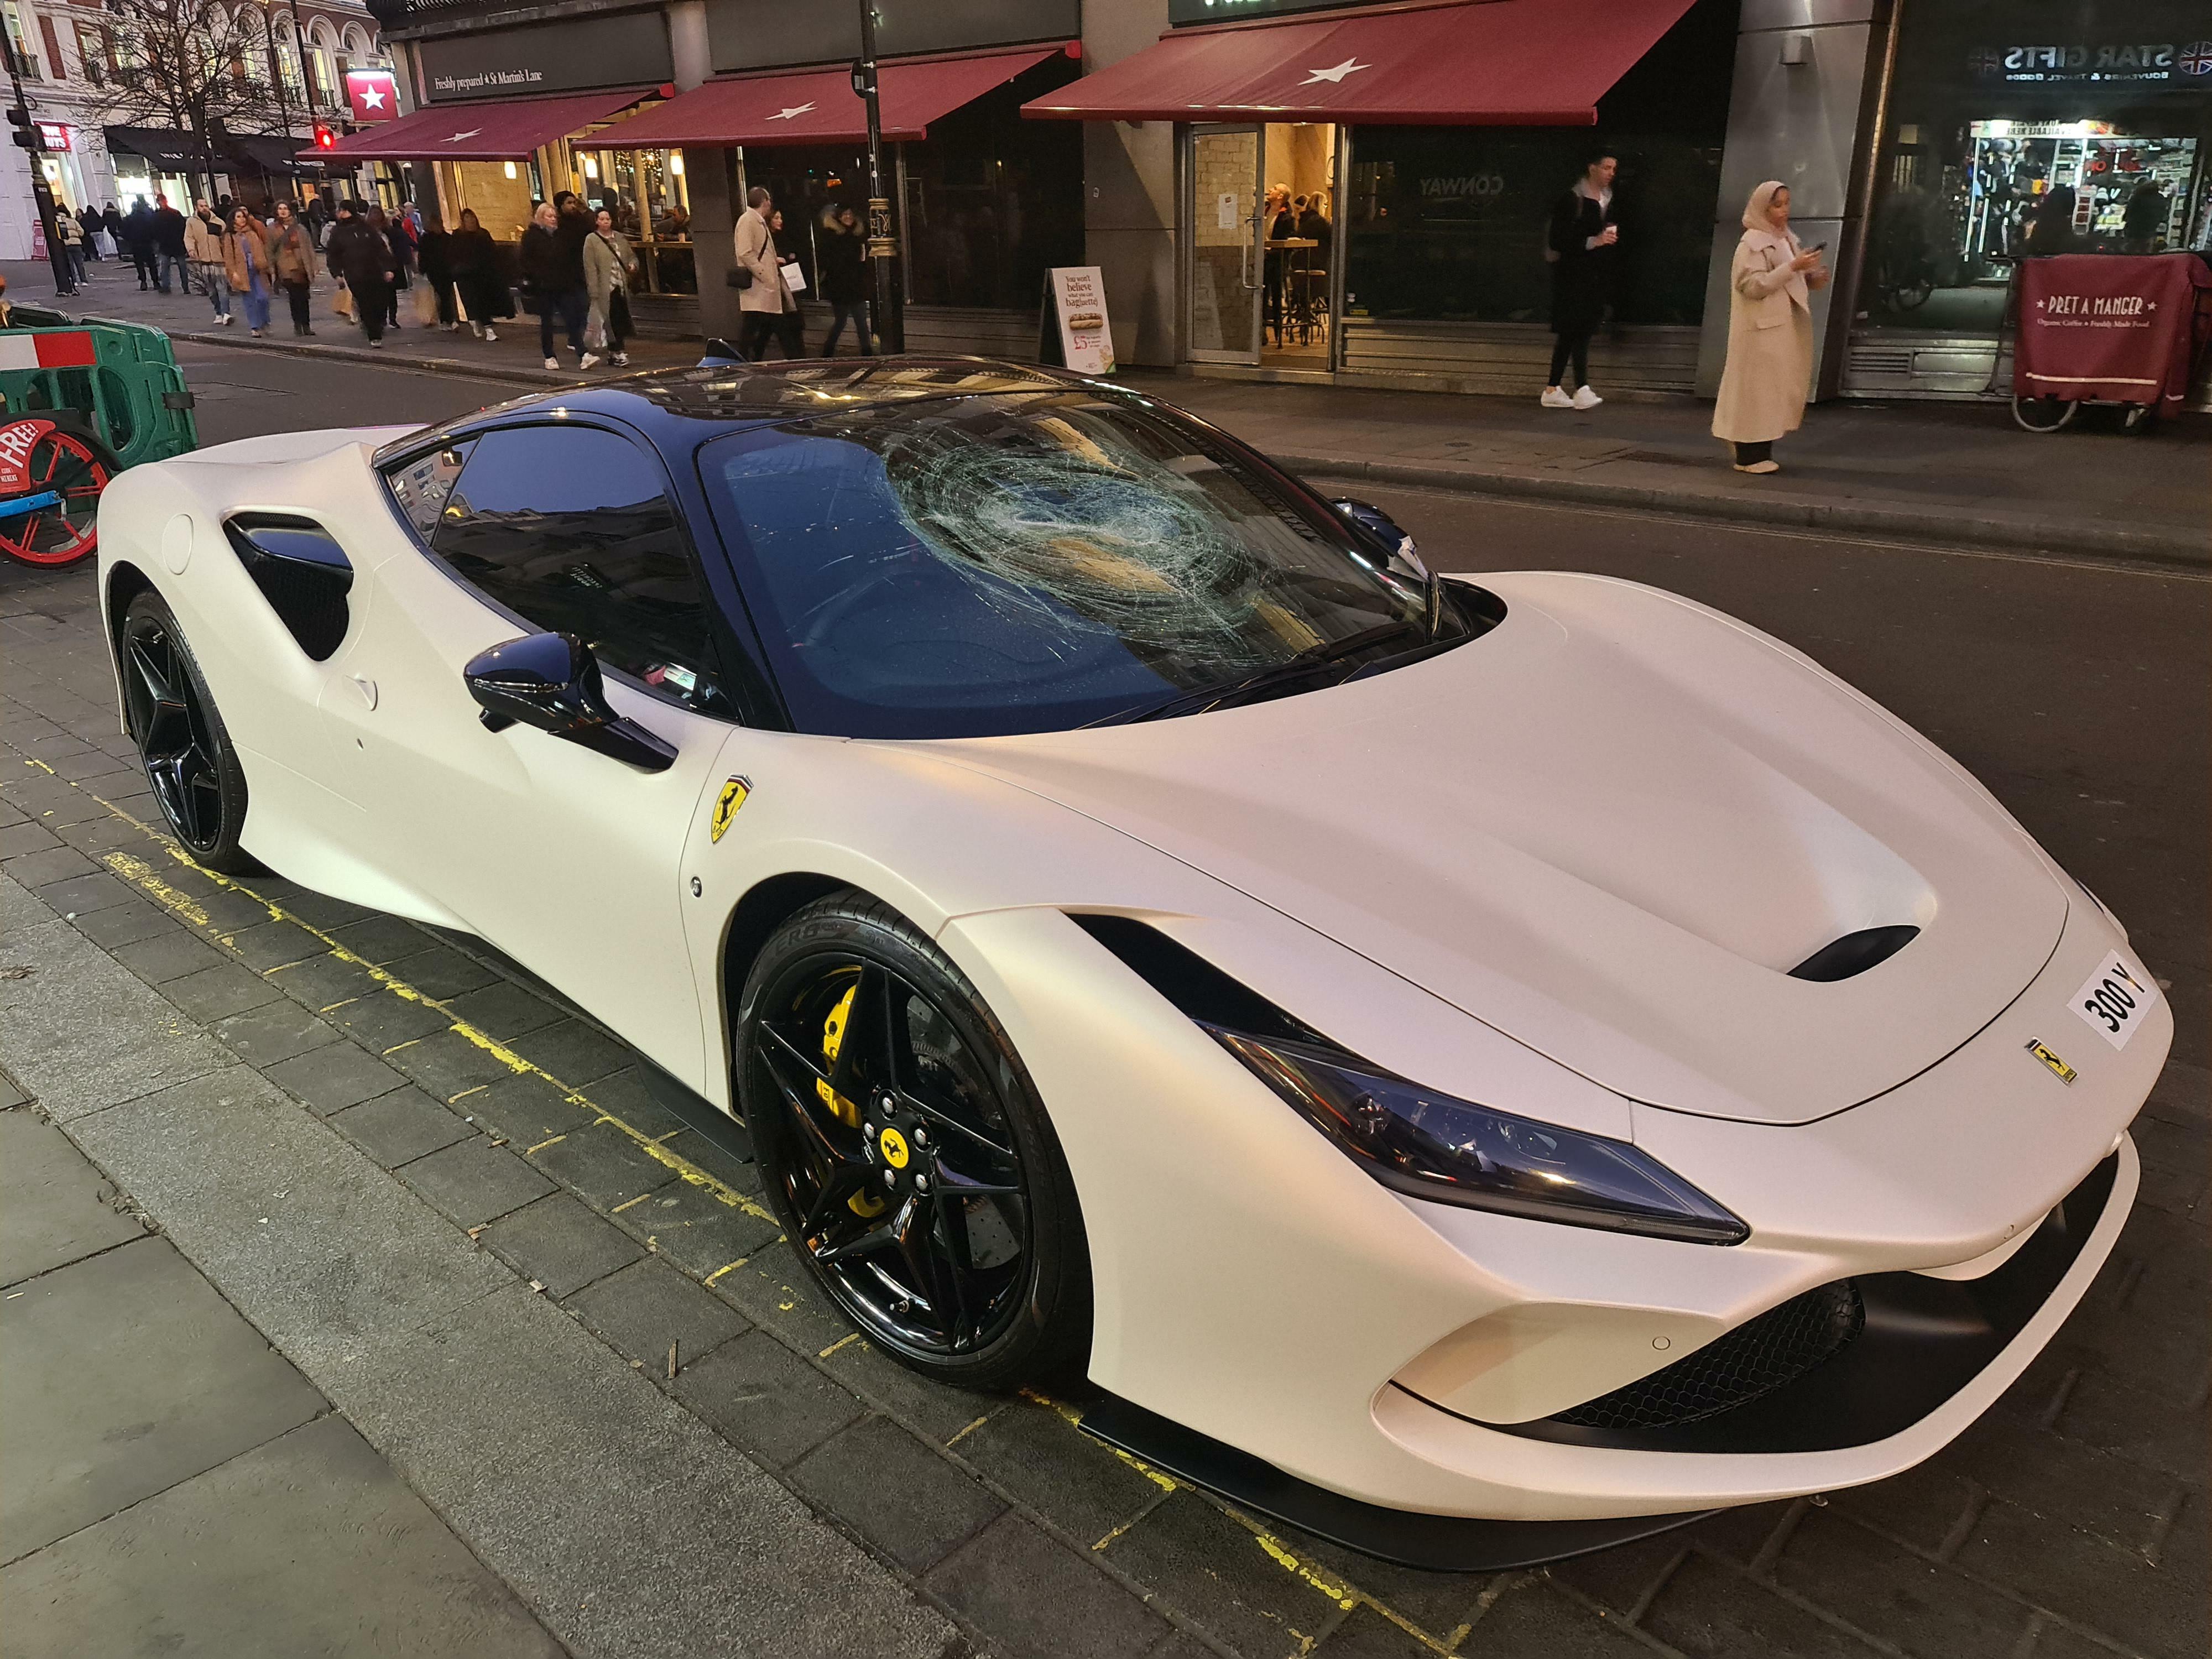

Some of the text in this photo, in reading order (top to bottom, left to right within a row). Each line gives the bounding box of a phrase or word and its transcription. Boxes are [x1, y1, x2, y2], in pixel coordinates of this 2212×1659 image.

[435, 69, 542, 91] Freshly prepared St Martin's Lane
[1067, 282, 1092, 291] believe
[2048, 295, 2143, 315] PRET A MANGER
[1074, 336, 1087, 349] £5
[2084, 962, 2145, 1032] 300 Y
